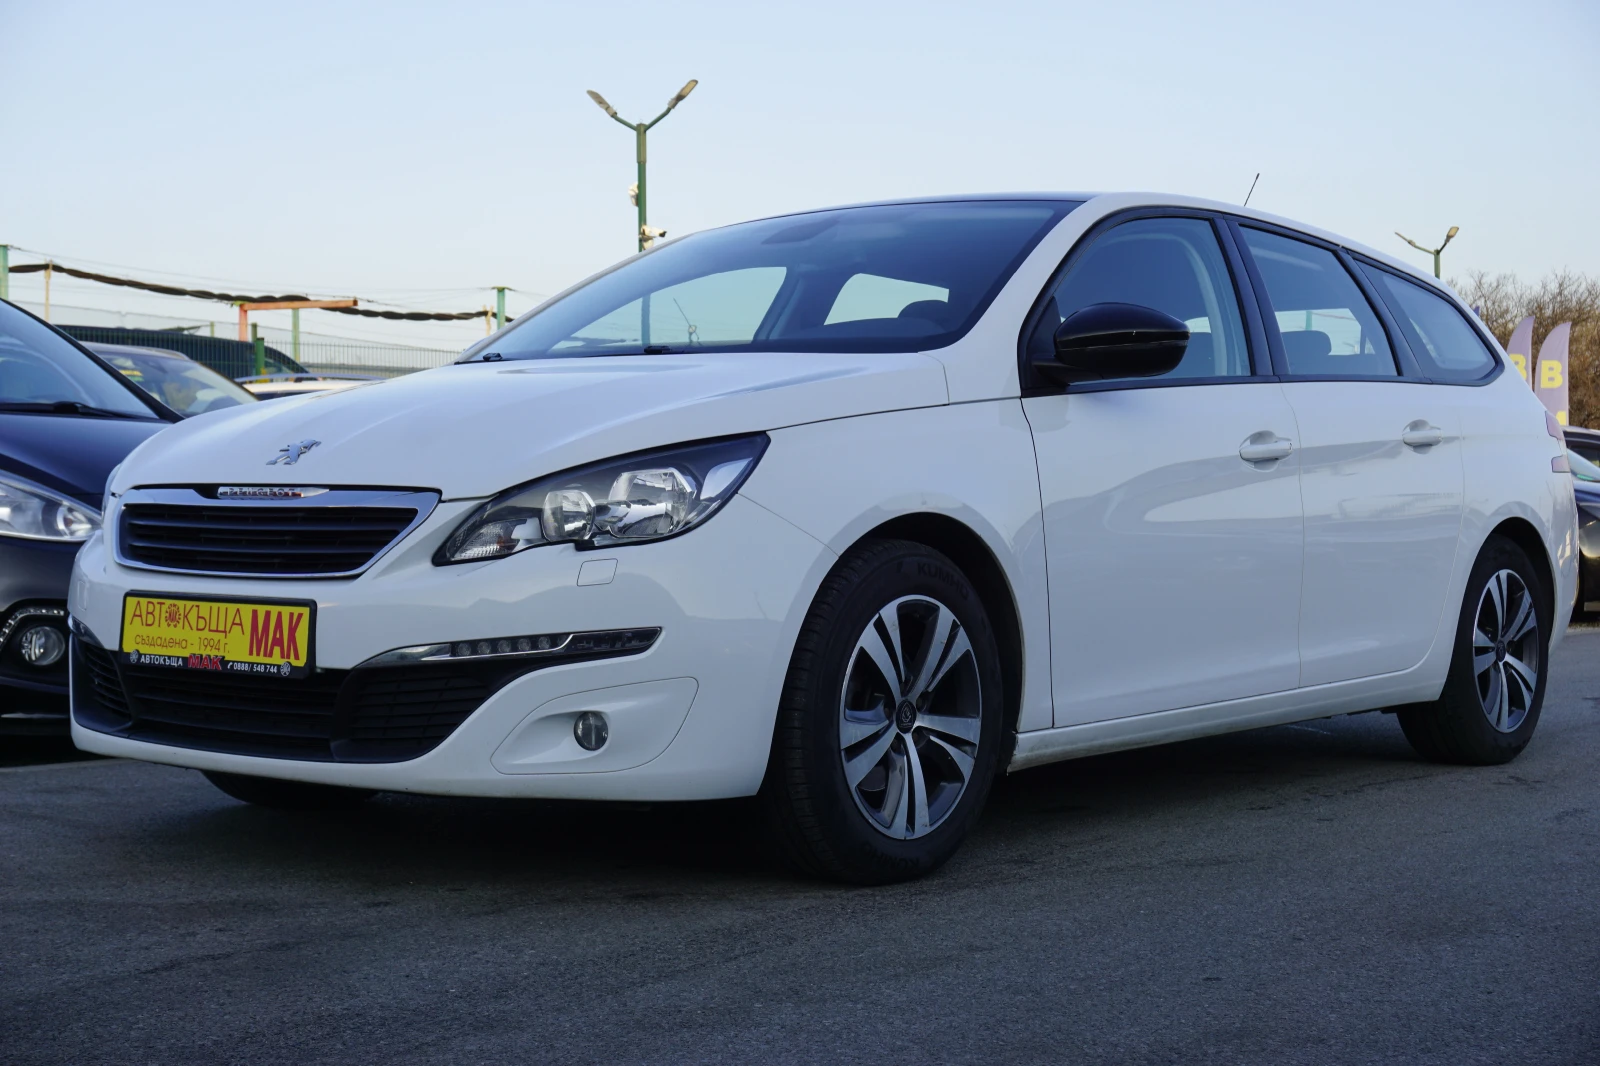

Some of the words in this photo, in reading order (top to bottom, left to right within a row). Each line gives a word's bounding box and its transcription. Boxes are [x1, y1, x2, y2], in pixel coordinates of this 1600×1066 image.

[228, 487, 295, 496] PEUGEOT
[917, 562, 969, 601] KUMHO
[134, 634, 188, 649] създадена
[198, 637, 221, 653] 1994
[140, 654, 183, 667] АВТОКЪЩА
[266, 665, 278, 674] 744
